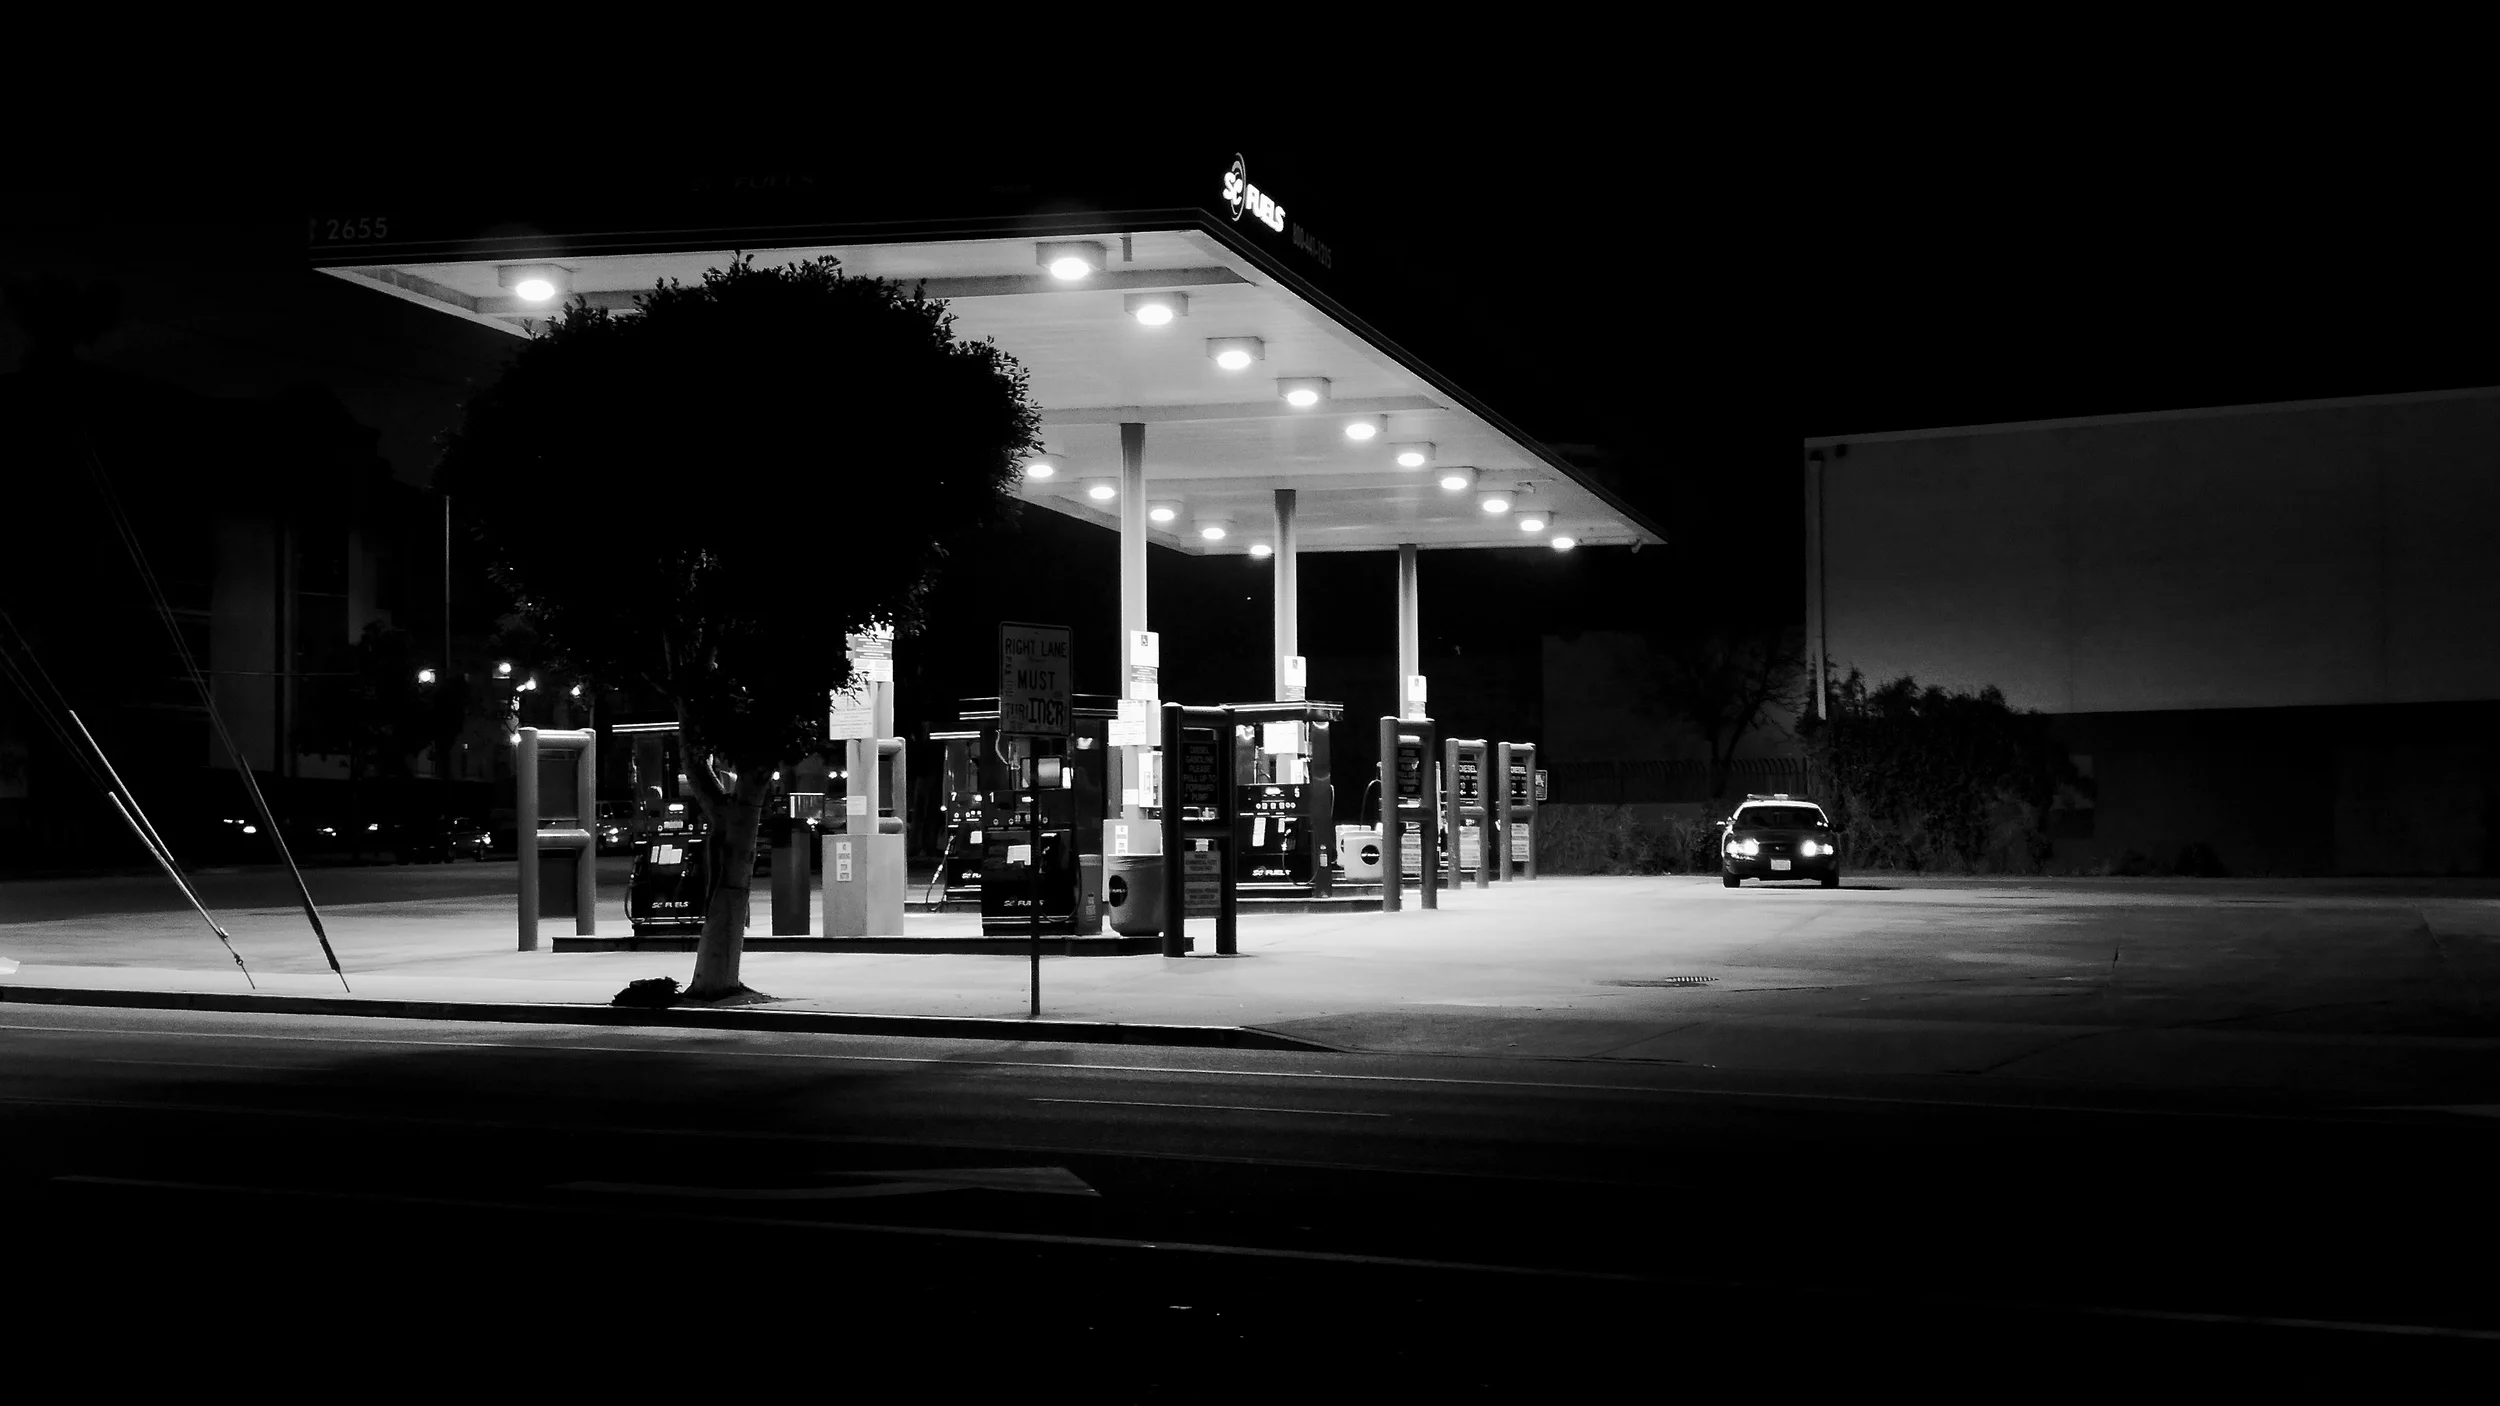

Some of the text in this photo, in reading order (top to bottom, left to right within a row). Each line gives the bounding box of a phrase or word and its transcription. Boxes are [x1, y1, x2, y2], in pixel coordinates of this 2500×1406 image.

[1246, 183, 1286, 233] FUELS
[326, 216, 388, 240] 2655
[1005, 638, 1068, 658] RIGHT LANE
[1017, 670, 1056, 690] MUST
[951, 791, 957, 801] 7
[989, 791, 995, 803] 1
[1294, 786, 1301, 798] 5
